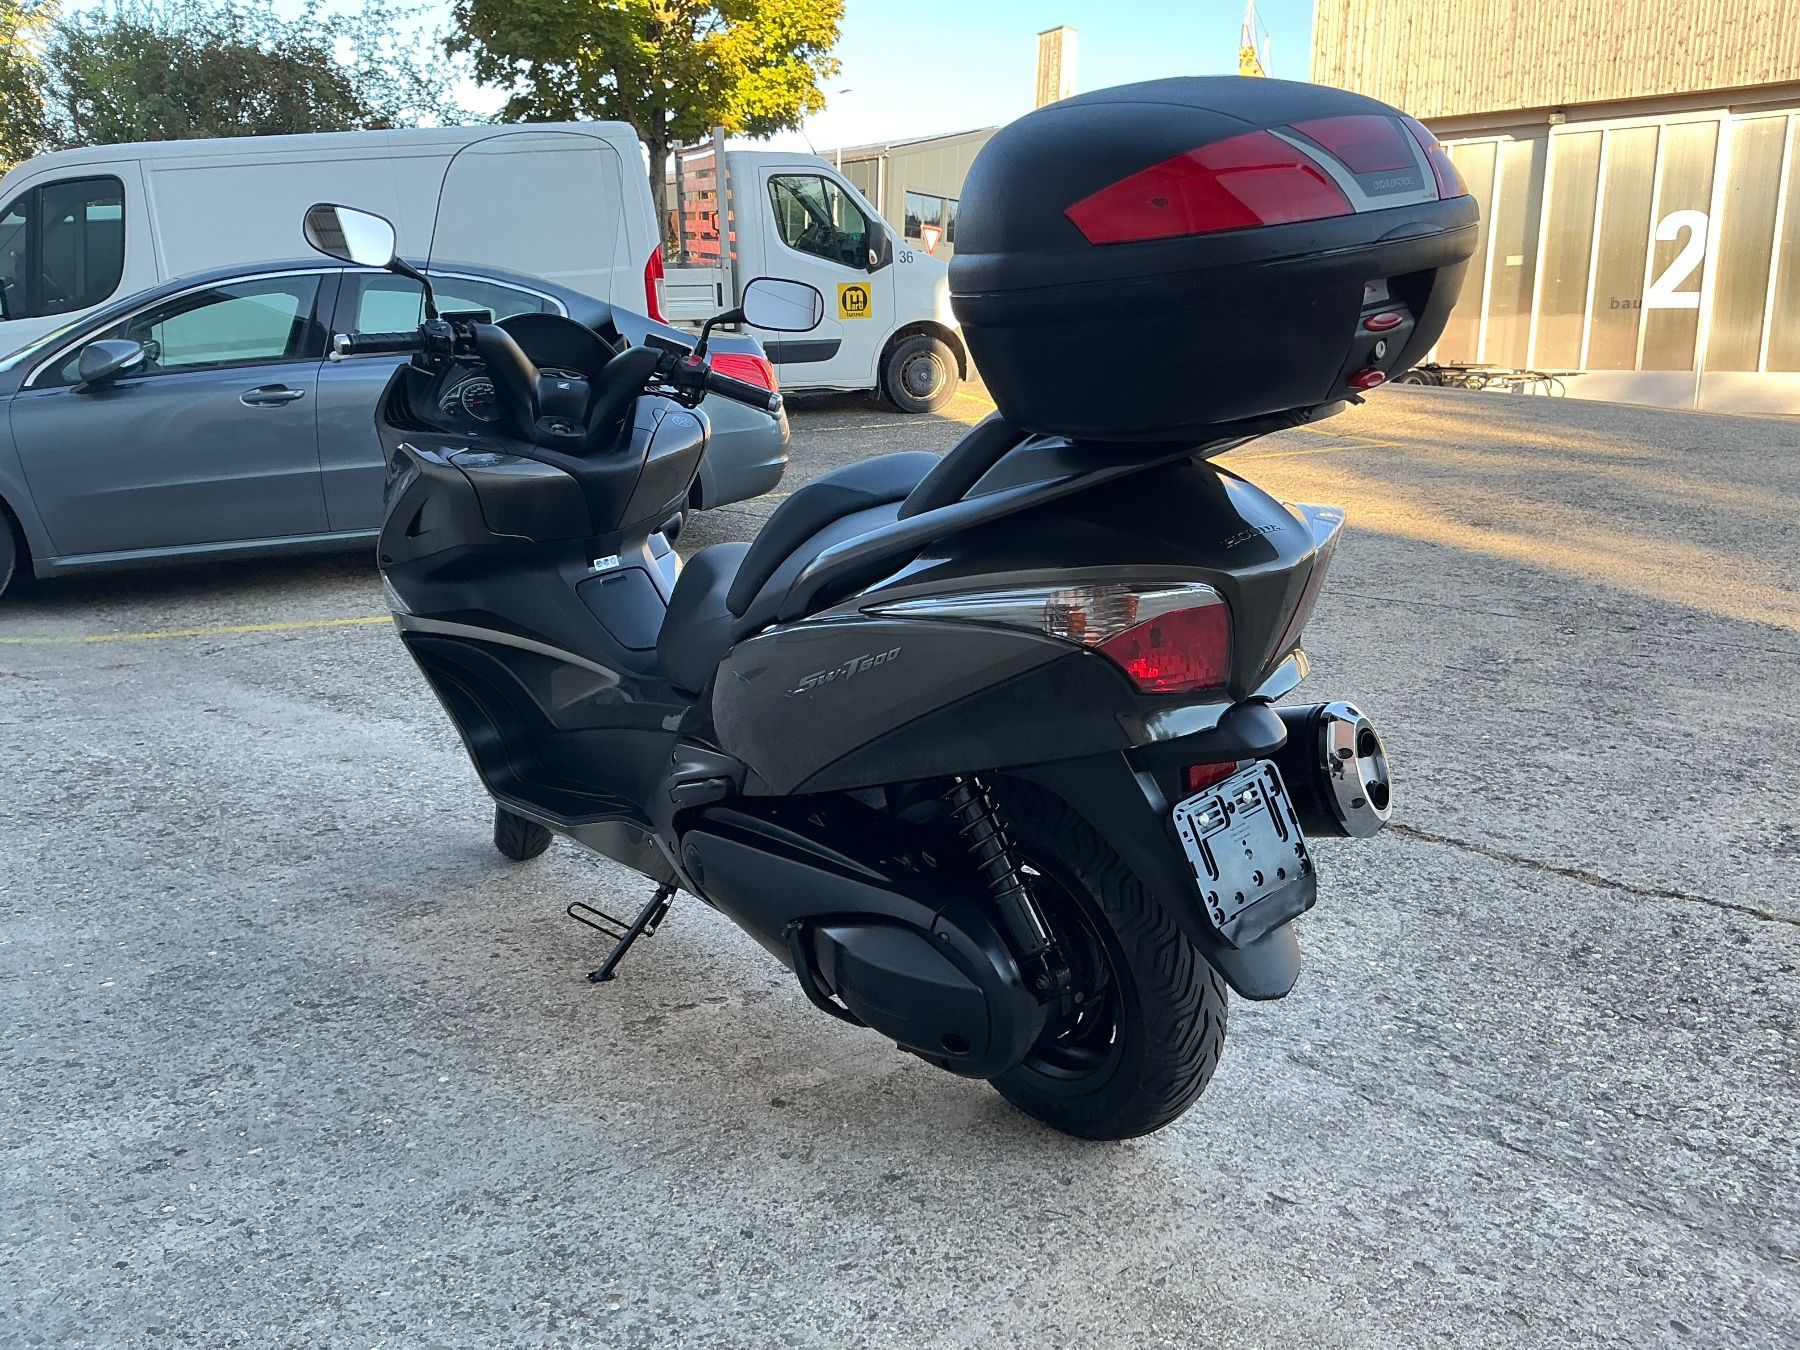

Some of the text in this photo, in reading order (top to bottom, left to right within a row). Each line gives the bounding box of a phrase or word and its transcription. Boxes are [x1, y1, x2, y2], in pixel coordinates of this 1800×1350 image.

[899, 250, 914, 264] 36
[1609, 208, 1710, 310] bau 2
